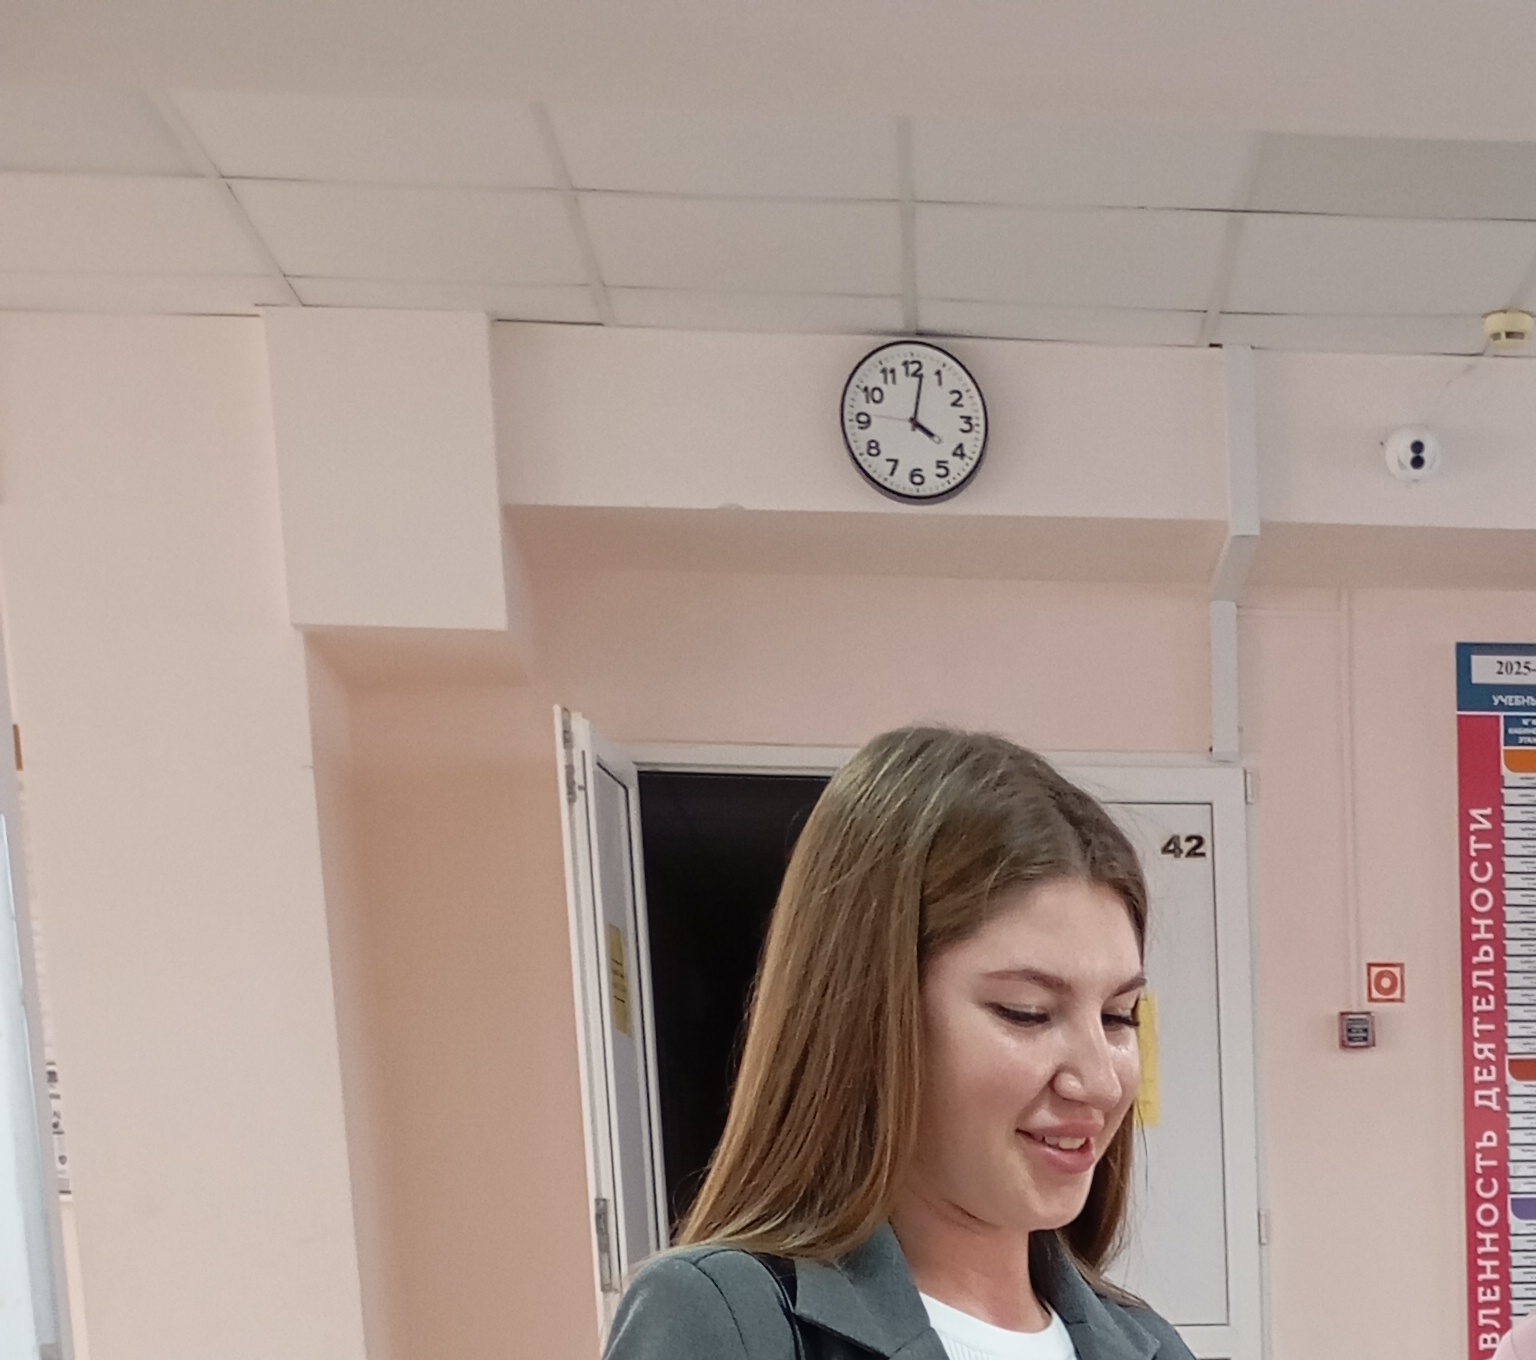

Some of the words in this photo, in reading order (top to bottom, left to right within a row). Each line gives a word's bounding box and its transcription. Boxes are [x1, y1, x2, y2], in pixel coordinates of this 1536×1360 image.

[880, 367, 896, 385] 11
[902, 360, 923, 378] 12
[935, 369, 943, 387] 1
[863, 387, 884, 404] 10
[949, 390, 964, 407] 2
[856, 412, 871, 430] 9
[959, 415, 973, 433] 3
[866, 440, 881, 457] 8
[952, 443, 966, 460] 4
[886, 459, 899, 477] 7
[935, 460, 950, 478] 5
[909, 469, 925, 486] 6
[1161, 835, 1207, 859] 42
[1469, 807, 1501, 1111] ДЕЯТЕЛЬНОСТИ
